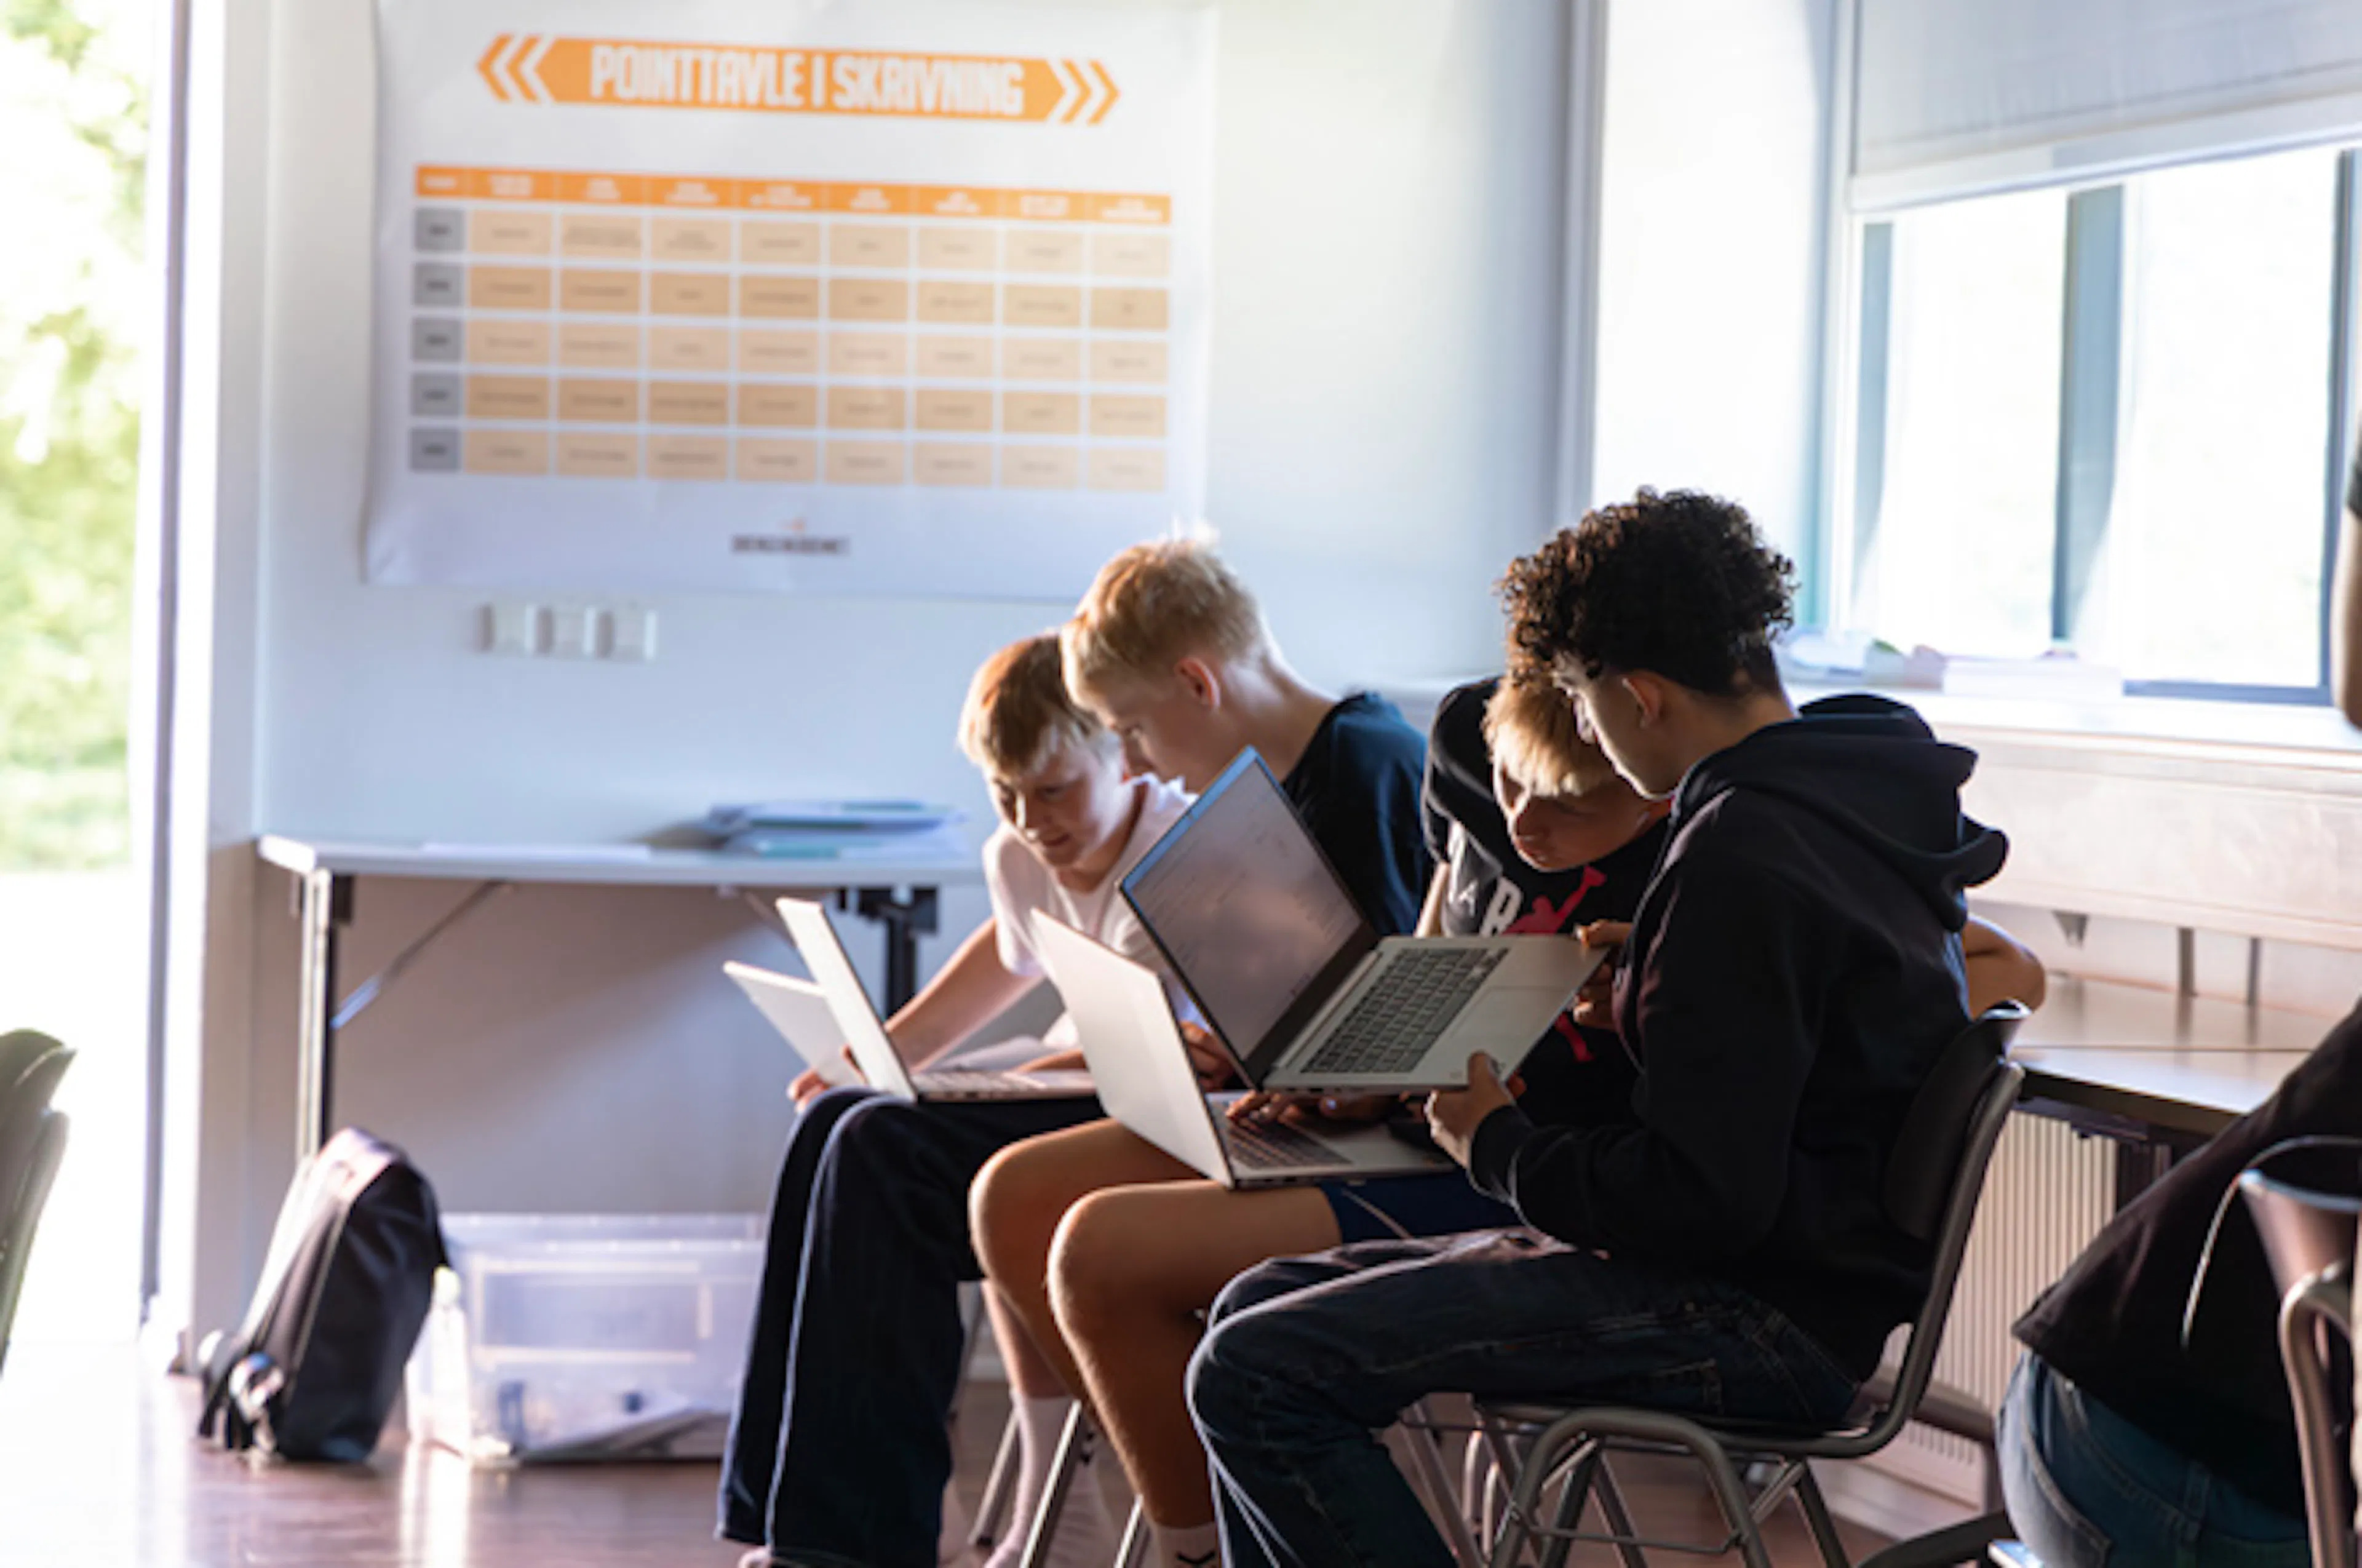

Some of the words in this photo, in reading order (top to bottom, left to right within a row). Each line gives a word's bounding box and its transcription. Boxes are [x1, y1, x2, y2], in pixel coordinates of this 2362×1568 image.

[592, 46, 803, 106] POINTTAVLE
[813, 55, 825, 107] I
[834, 57, 1023, 114] SKRIVNING
